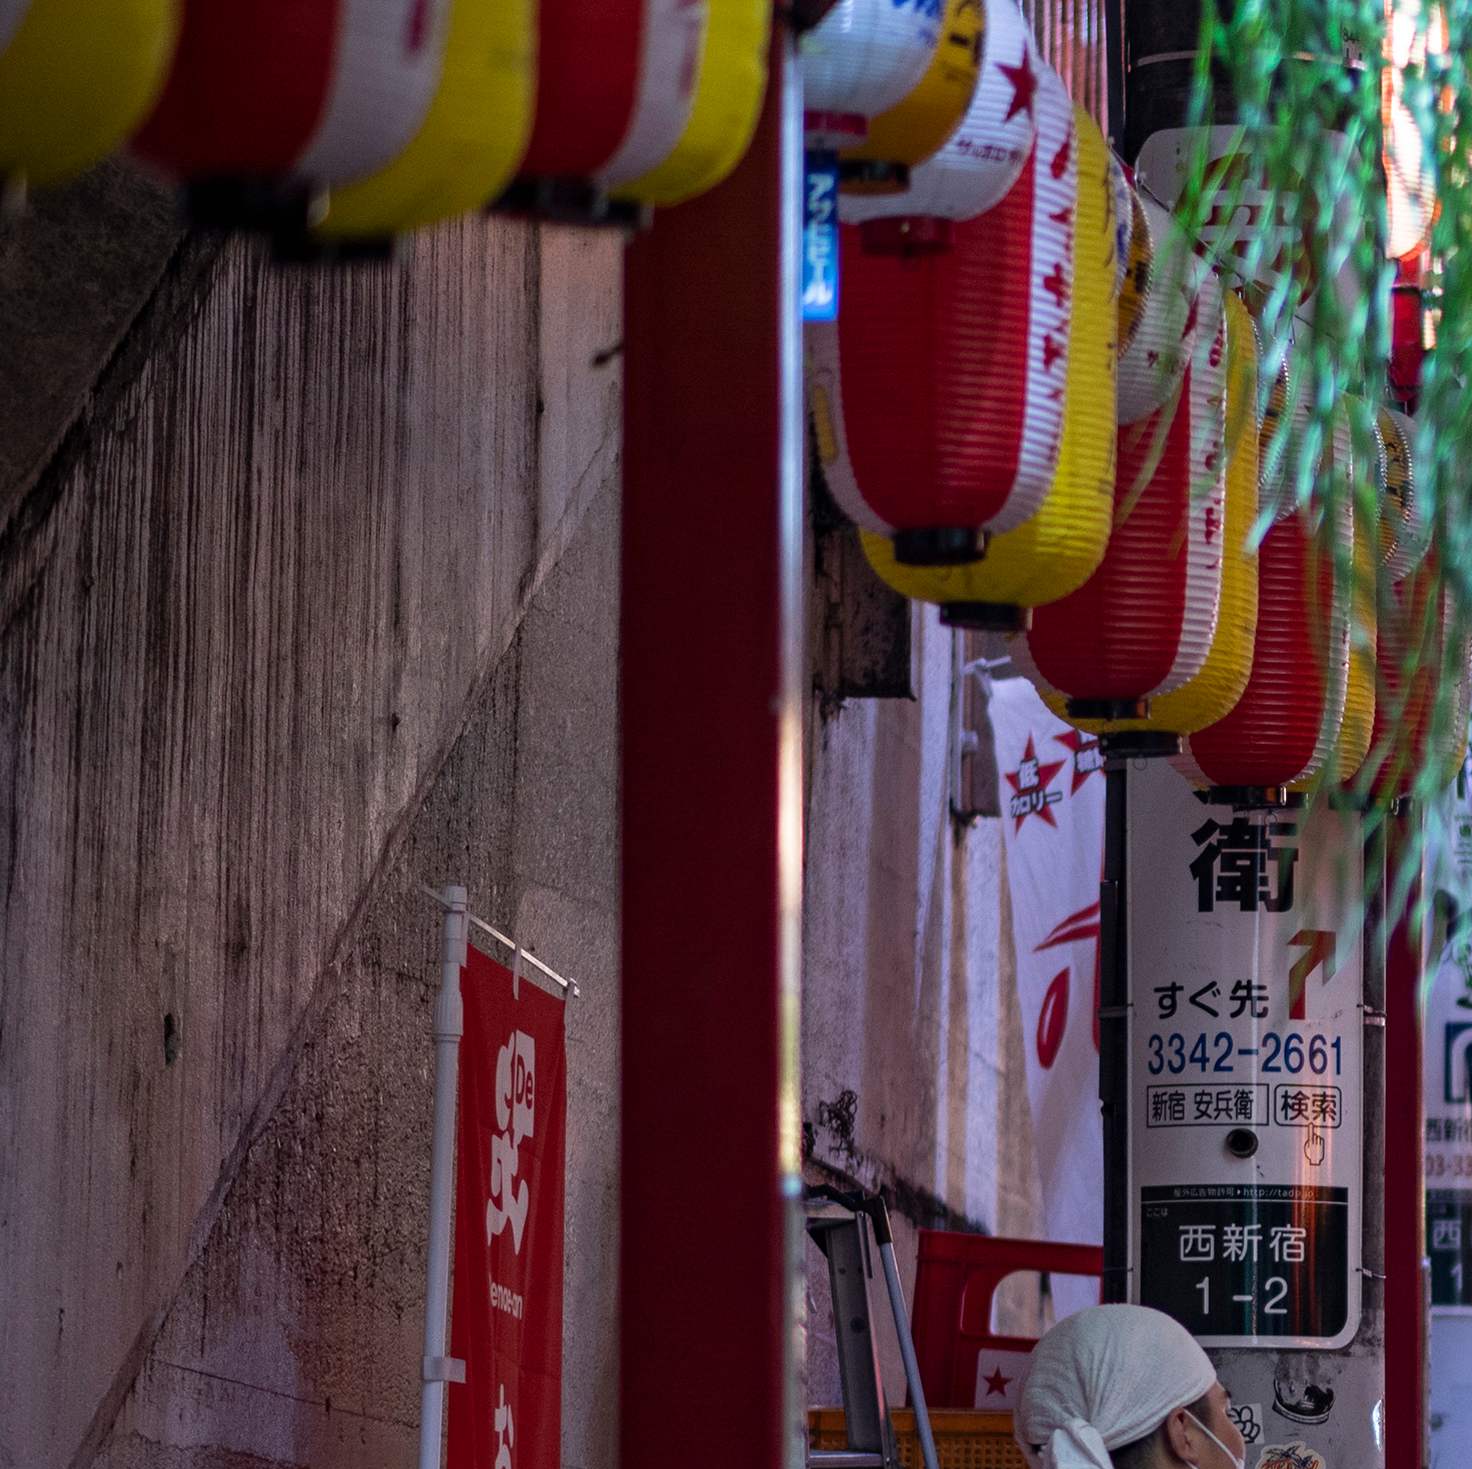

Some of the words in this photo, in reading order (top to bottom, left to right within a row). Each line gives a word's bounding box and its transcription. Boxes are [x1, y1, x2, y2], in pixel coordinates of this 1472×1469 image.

[1153, 979, 1270, 1019] すぐ先
[1148, 1031, 1342, 1075] 3342-2661
[1152, 1091, 1186, 1122] 新宿
[1193, 1089, 1254, 1120] 安兵衛
[1280, 1091, 1337, 1122] 検索
[1178, 1223, 1307, 1263] 西新宿
[1195, 1276, 1288, 1315] 1-2
